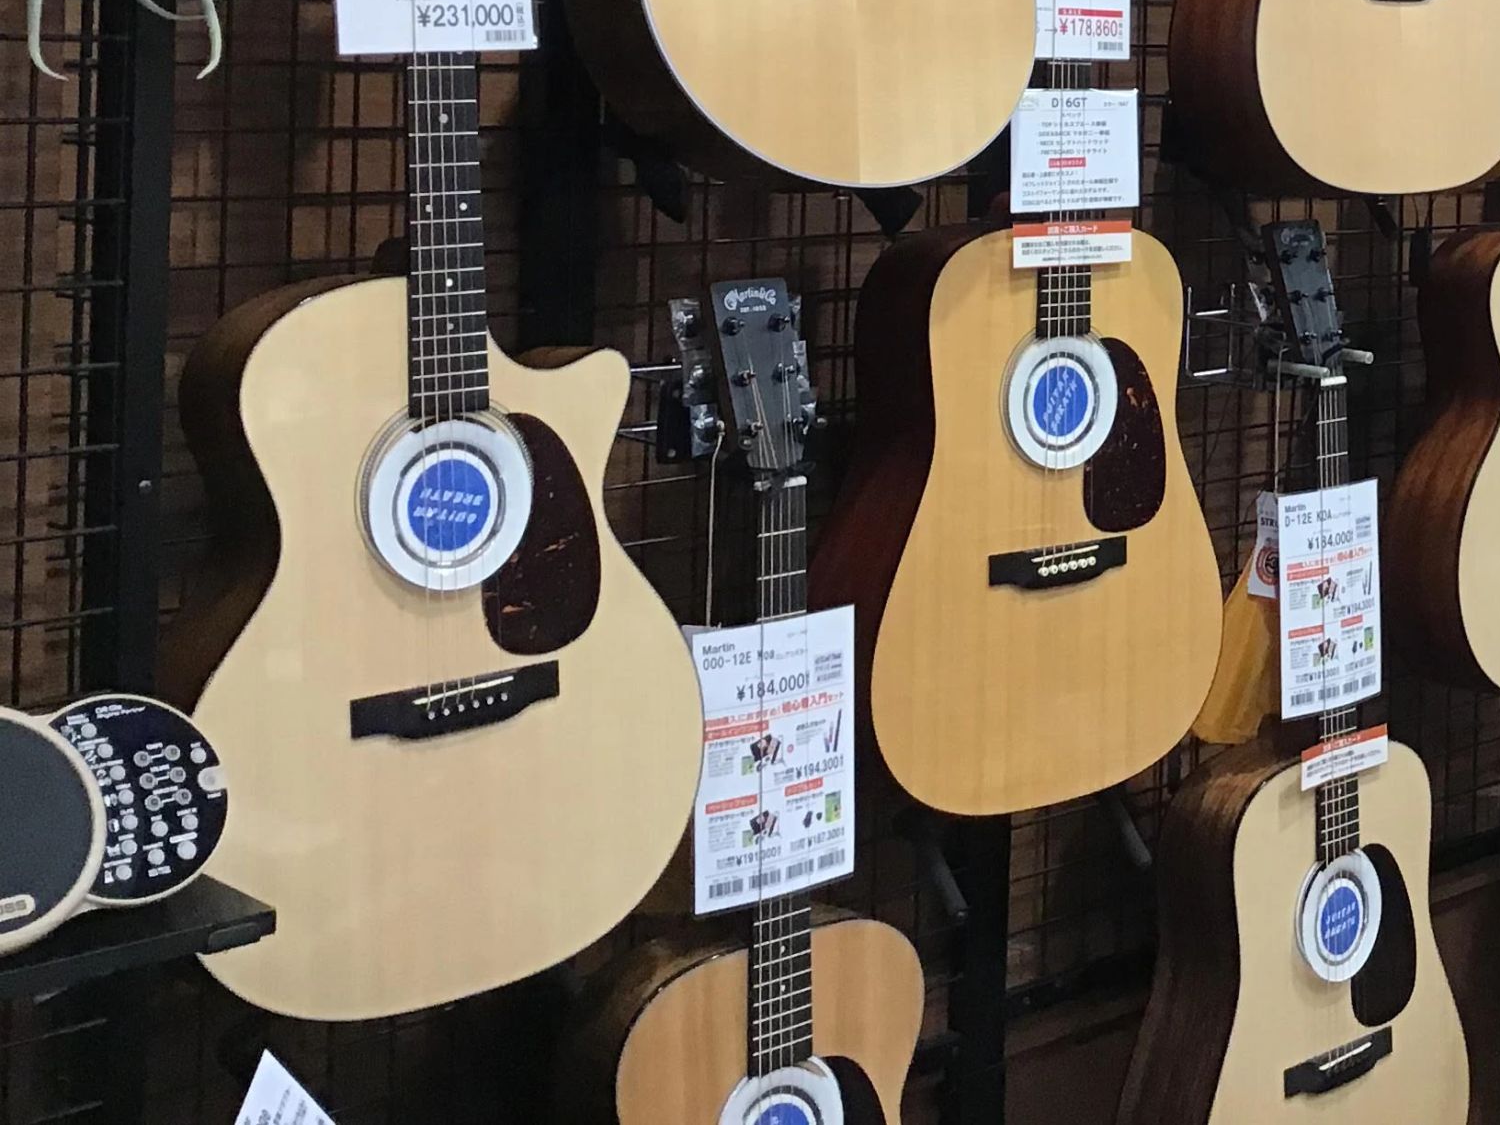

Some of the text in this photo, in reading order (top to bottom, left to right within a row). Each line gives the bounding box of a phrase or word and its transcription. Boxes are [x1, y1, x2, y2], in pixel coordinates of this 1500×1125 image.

[417, 3, 515, 28] ¥231,000
[1059, 18, 1118, 37] ¥178,860
[1285, 504, 1306, 513] Martin
[1285, 512, 1312, 527] D-12E
[702, 642, 735, 655] Martin
[703, 651, 752, 671] 000-12E
[736, 673, 805, 702] ¥184,000
